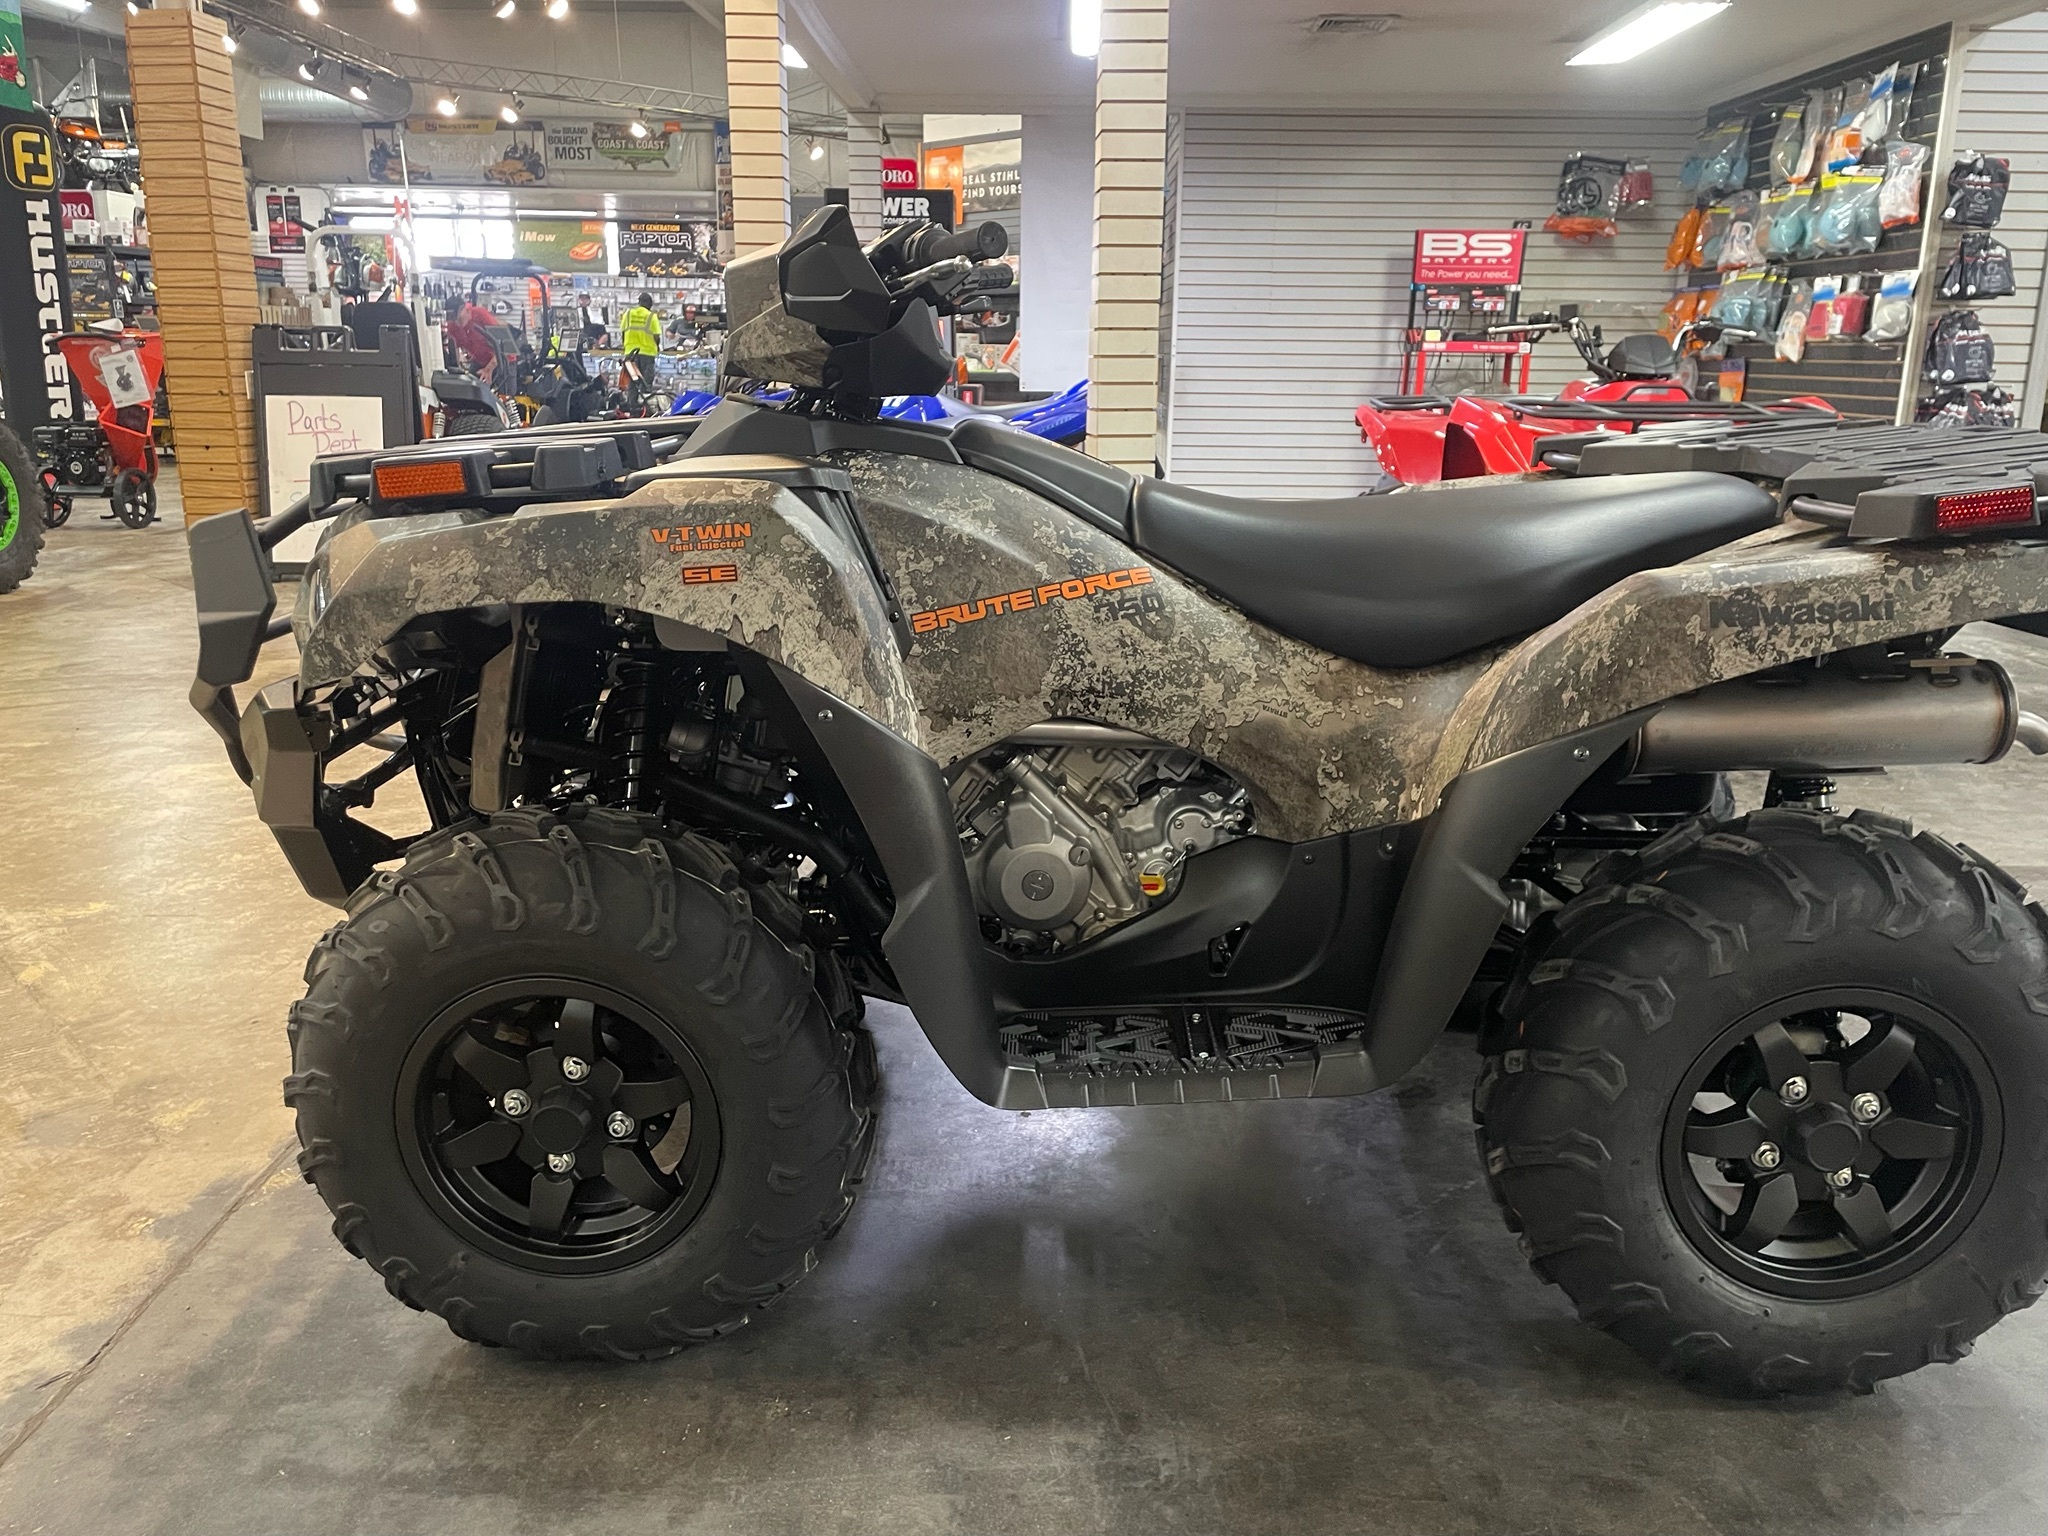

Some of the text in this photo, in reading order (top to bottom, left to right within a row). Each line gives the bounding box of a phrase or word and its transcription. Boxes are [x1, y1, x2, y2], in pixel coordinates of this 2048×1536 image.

[562, 127, 588, 135] BRAND
[548, 136, 583, 145] BOUGHT
[598, 139, 626, 149] COAST
[636, 139, 665, 149] COAST
[555, 147, 593, 160] MOST
[882, 169, 912, 183] ORO
[963, 170, 1020, 185] REAL STIHL
[963, 188, 985, 198] FIND
[882, 197, 930, 216] WER
[630, 223, 680, 232] NEXT GENERATION
[519, 231, 556, 242] iMow
[620, 231, 692, 248] RAPTOR
[1422, 233, 1513, 257] BS
[1421, 269, 1436, 278] The
[1437, 270, 1464, 278] Power
[1465, 272, 1481, 280] you
[26, 199, 73, 419] HUSTLER
[287, 400, 342, 434] Parts
[312, 430, 362, 453] Dept
[650, 522, 752, 543] V-TWIN
[669, 543, 694, 552] Fuel
[683, 565, 737, 584] SE
[911, 567, 1154, 634] BRUTE FORCE
[1093, 592, 1165, 621] 750
[1708, 593, 1894, 628] Kawasaki
